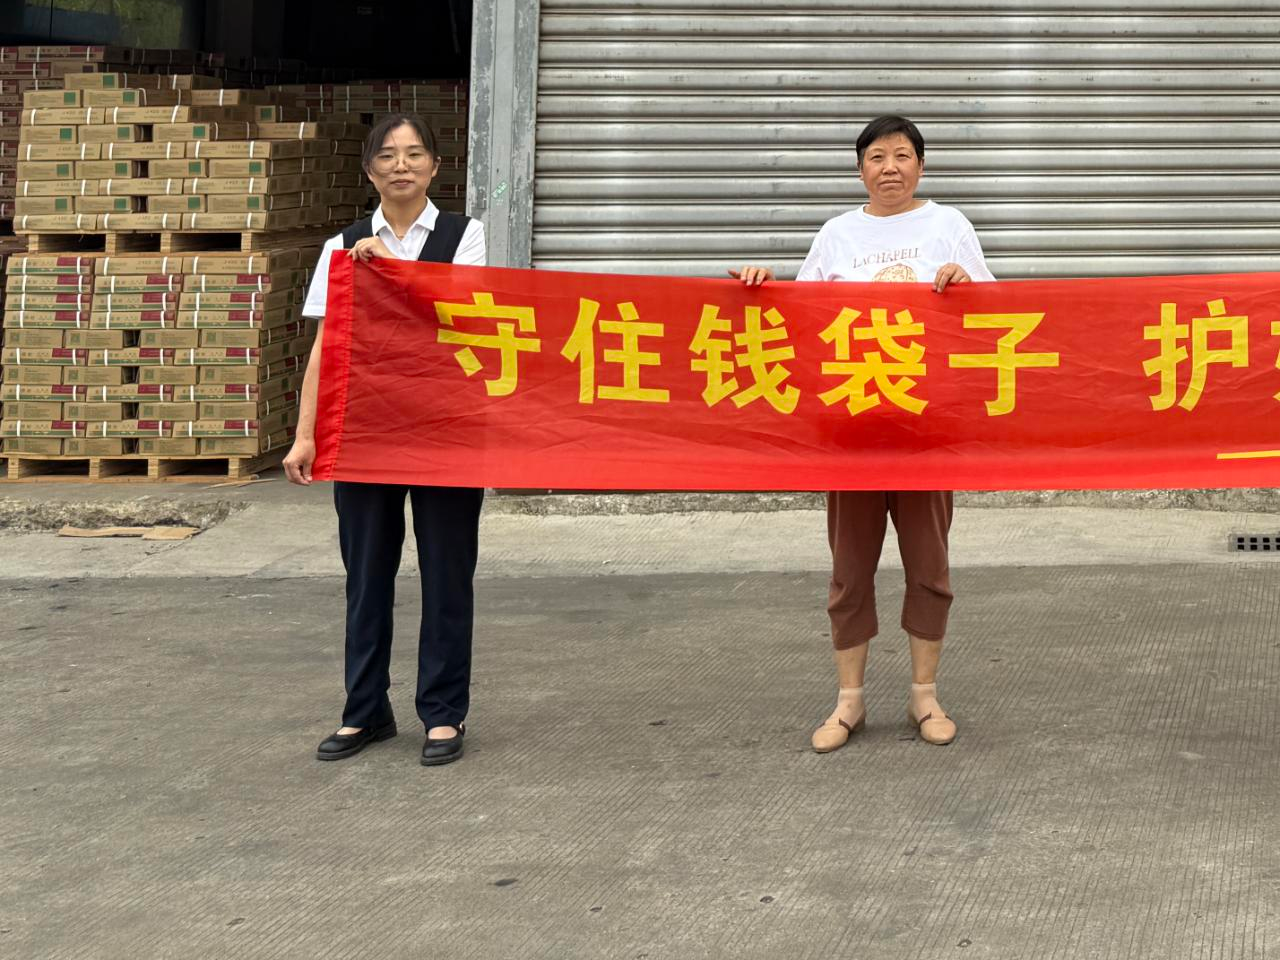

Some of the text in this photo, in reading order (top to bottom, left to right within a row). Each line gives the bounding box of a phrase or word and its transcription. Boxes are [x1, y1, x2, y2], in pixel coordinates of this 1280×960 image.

[436, 292, 1059, 416] 守住钱袋子
